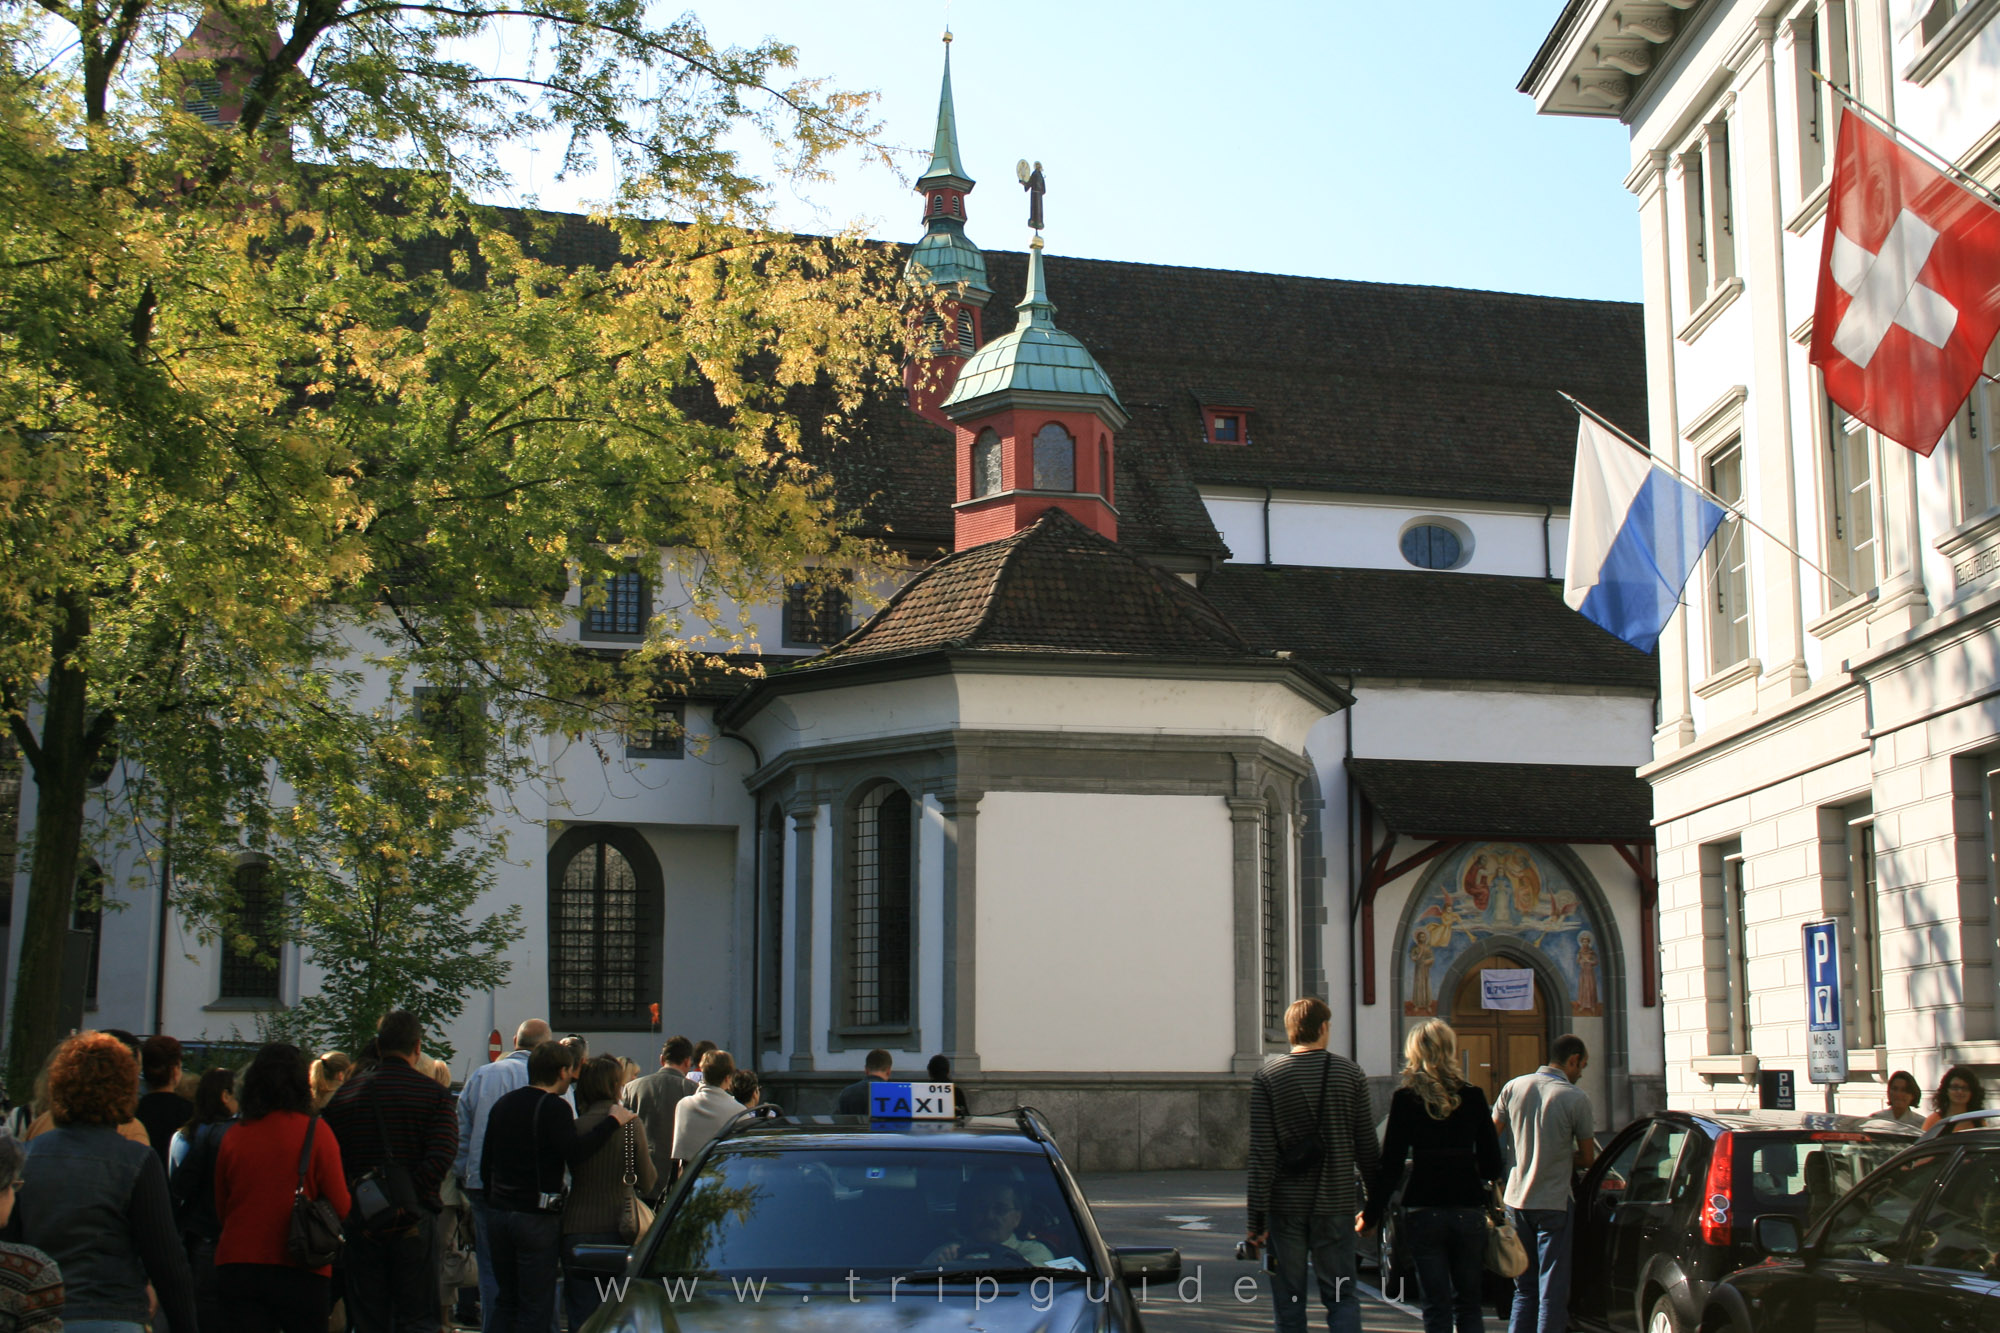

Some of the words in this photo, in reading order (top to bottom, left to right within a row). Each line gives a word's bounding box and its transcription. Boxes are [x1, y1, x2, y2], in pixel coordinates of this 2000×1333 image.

[1813, 932, 1829, 982] P
[1778, 1072, 1789, 1086] P
[928, 1085, 952, 1093] 015
[874, 1097, 944, 1113] TAXI
